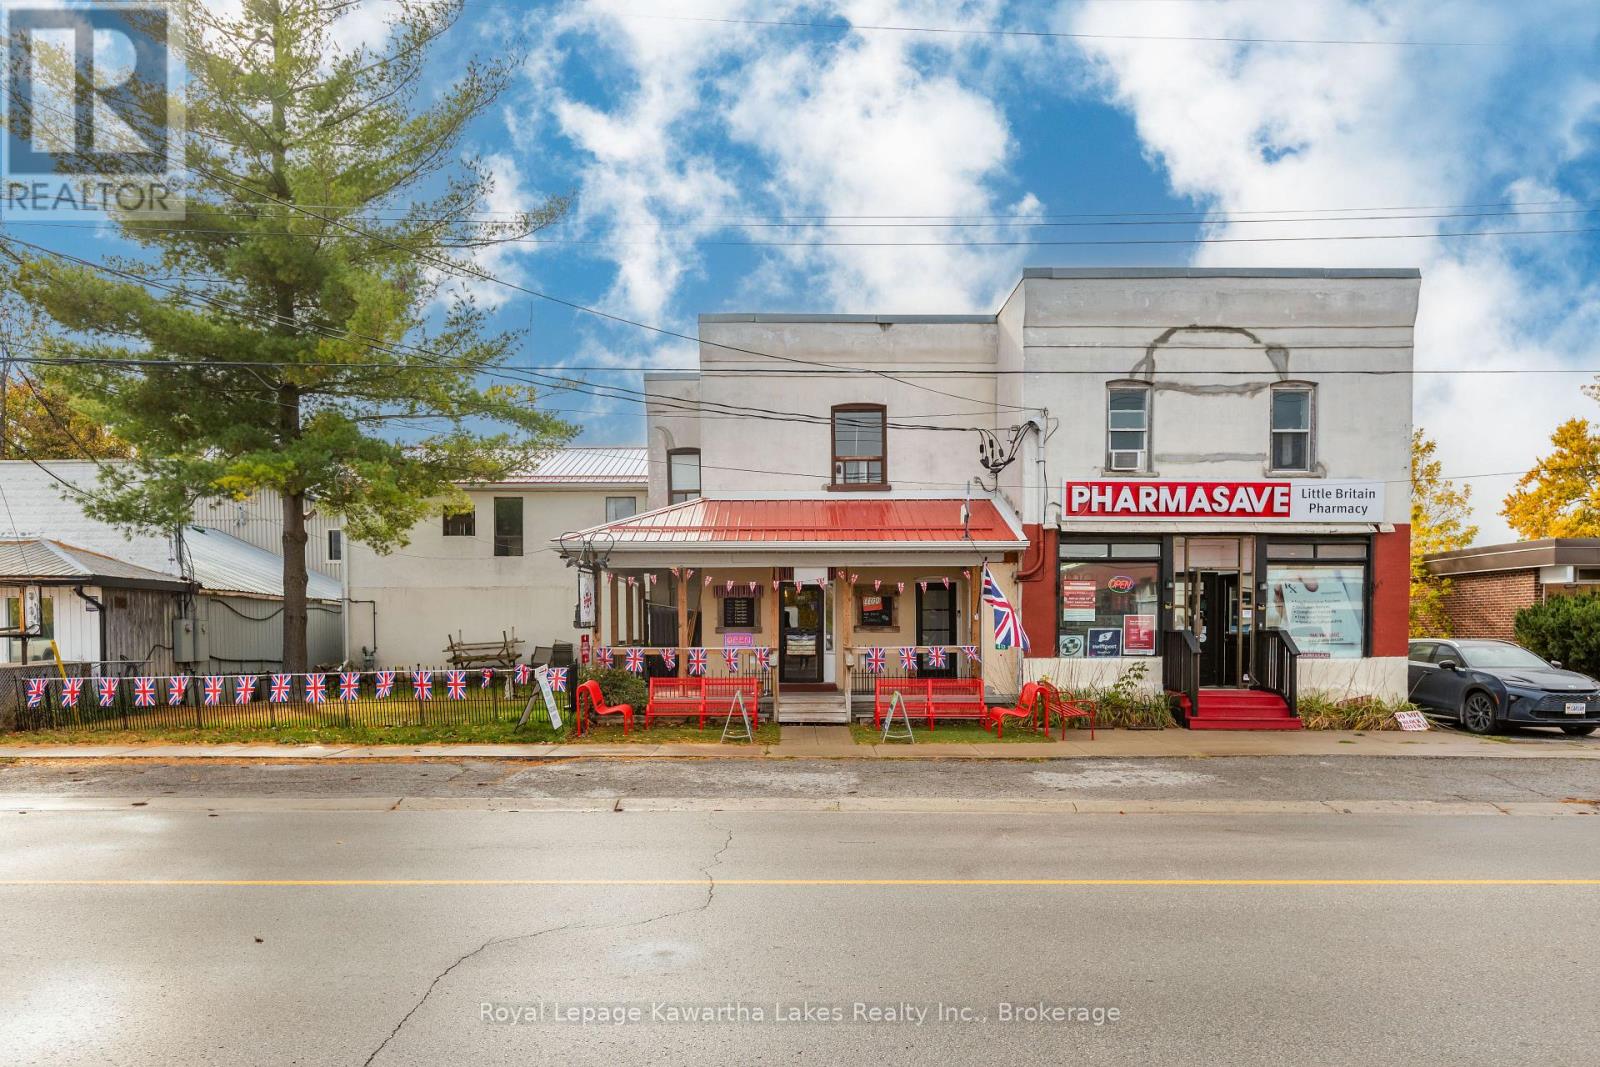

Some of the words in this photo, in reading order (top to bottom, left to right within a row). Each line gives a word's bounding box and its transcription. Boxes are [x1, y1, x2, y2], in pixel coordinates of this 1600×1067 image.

[1301, 488, 1332, 499] Little
[1335, 488, 1376, 499] Britain
[1071, 486, 1289, 513] PHARMASAVE
[1309, 503, 1368, 515] Pharmacy
[1110, 579, 1132, 589] OPEN
[727, 635, 751, 644] OPEN
